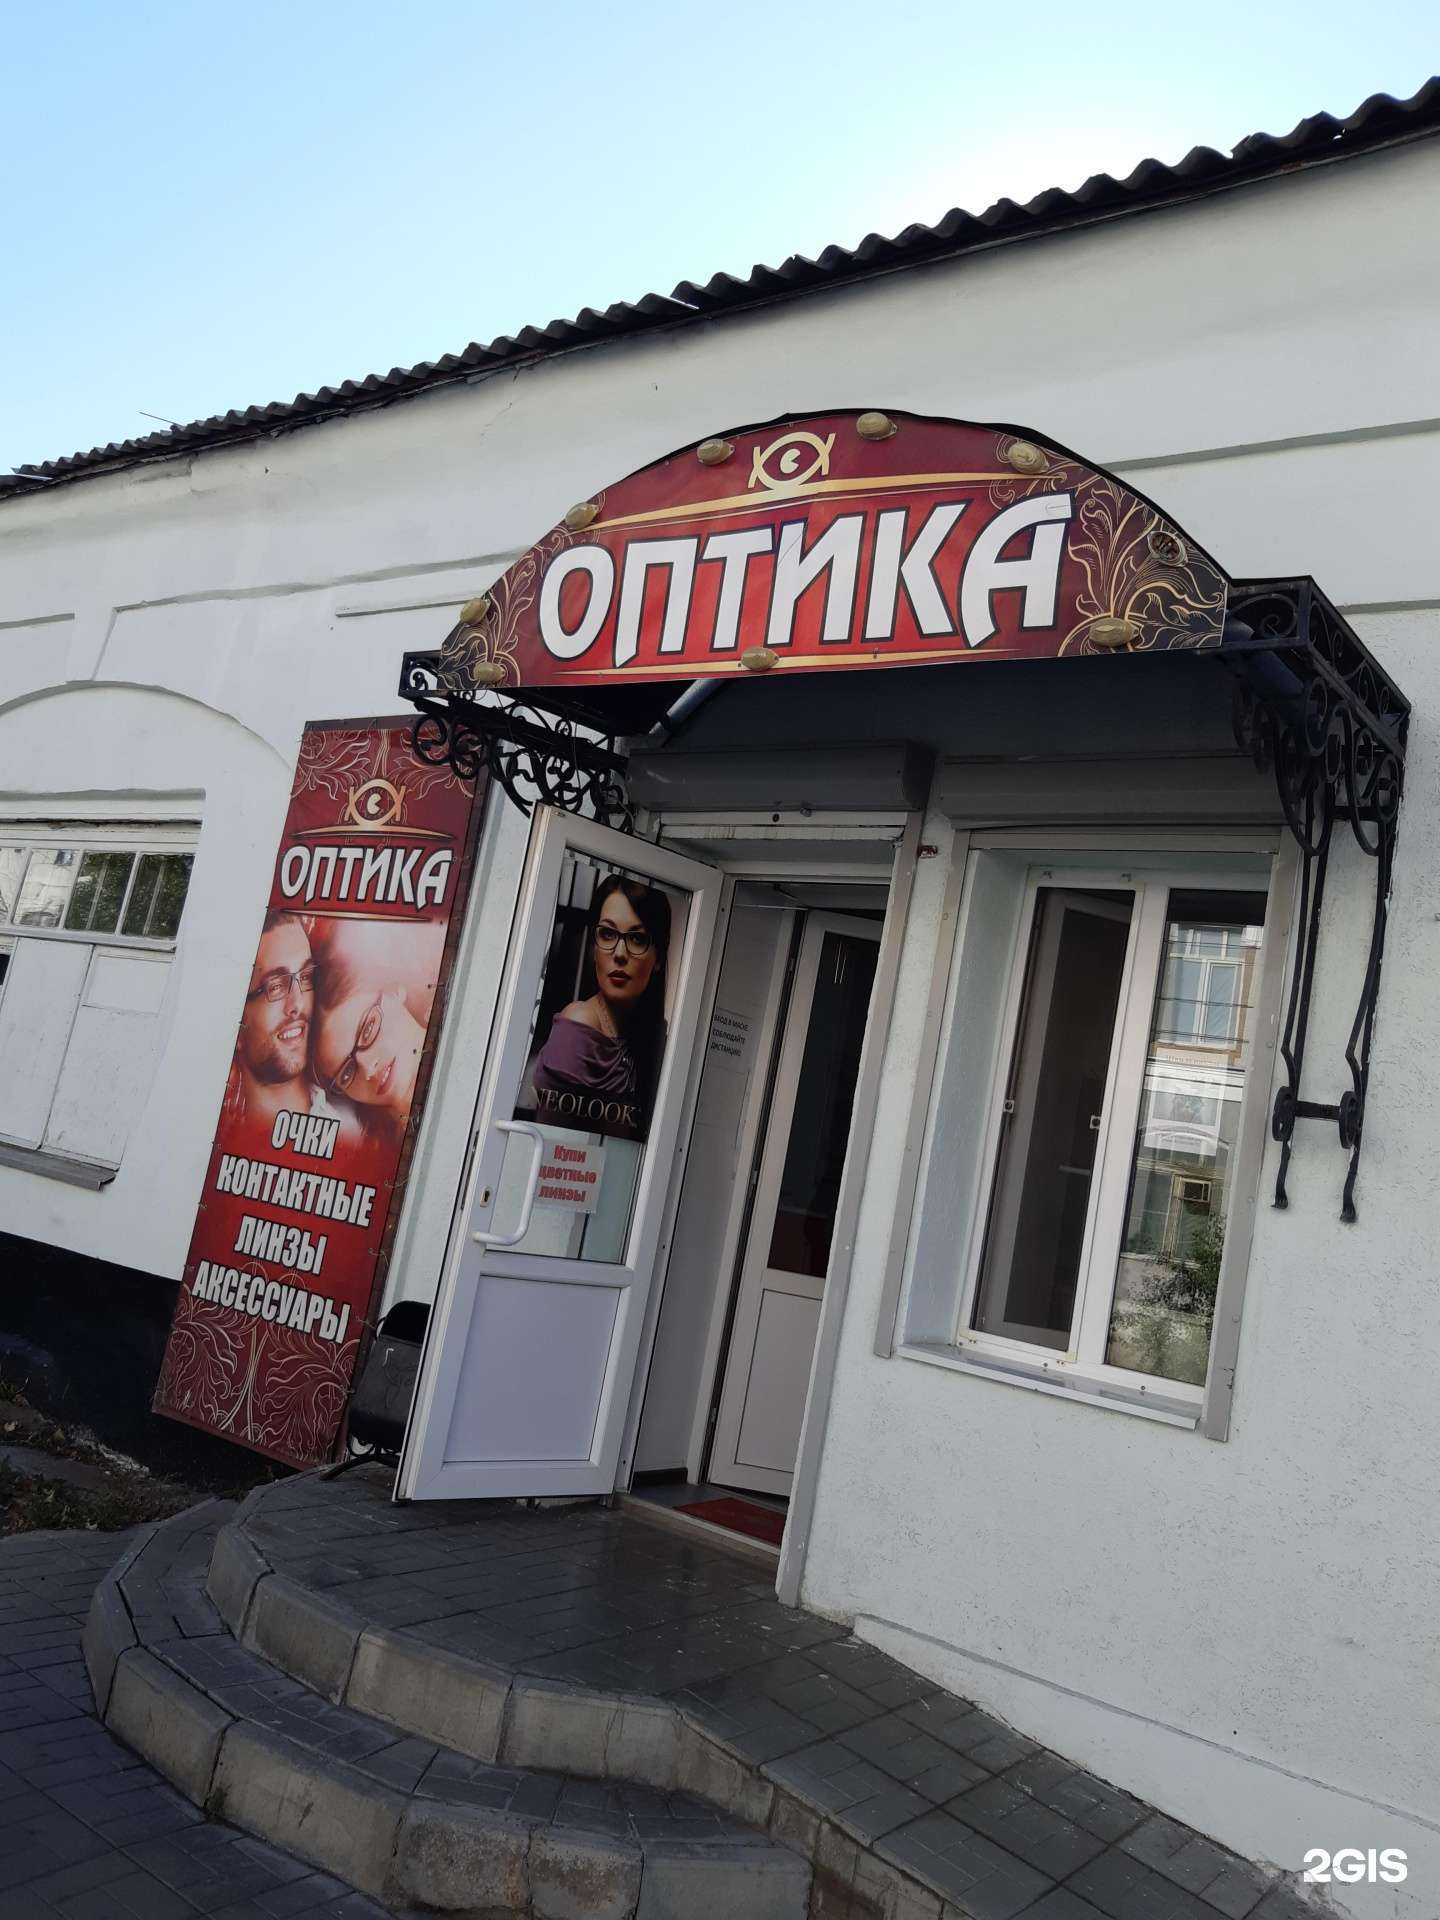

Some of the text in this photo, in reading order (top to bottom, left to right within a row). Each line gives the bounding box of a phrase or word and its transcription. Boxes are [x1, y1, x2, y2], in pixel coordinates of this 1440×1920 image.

[538, 493, 1074, 668] ОПТИКА
[281, 846, 453, 910] ОПТИКА
[271, 1110, 340, 1159] ОЧКИ
[532, 1086, 638, 1128] NEOLOOK
[554, 1145, 586, 1163] Купи
[216, 1154, 377, 1228] КОНТАКТНЫЕ
[539, 1186, 586, 1202] линзы
[234, 1215, 328, 1275] ЛИНЗЫ
[191, 1260, 351, 1344] АКСЕССУАРЫ
